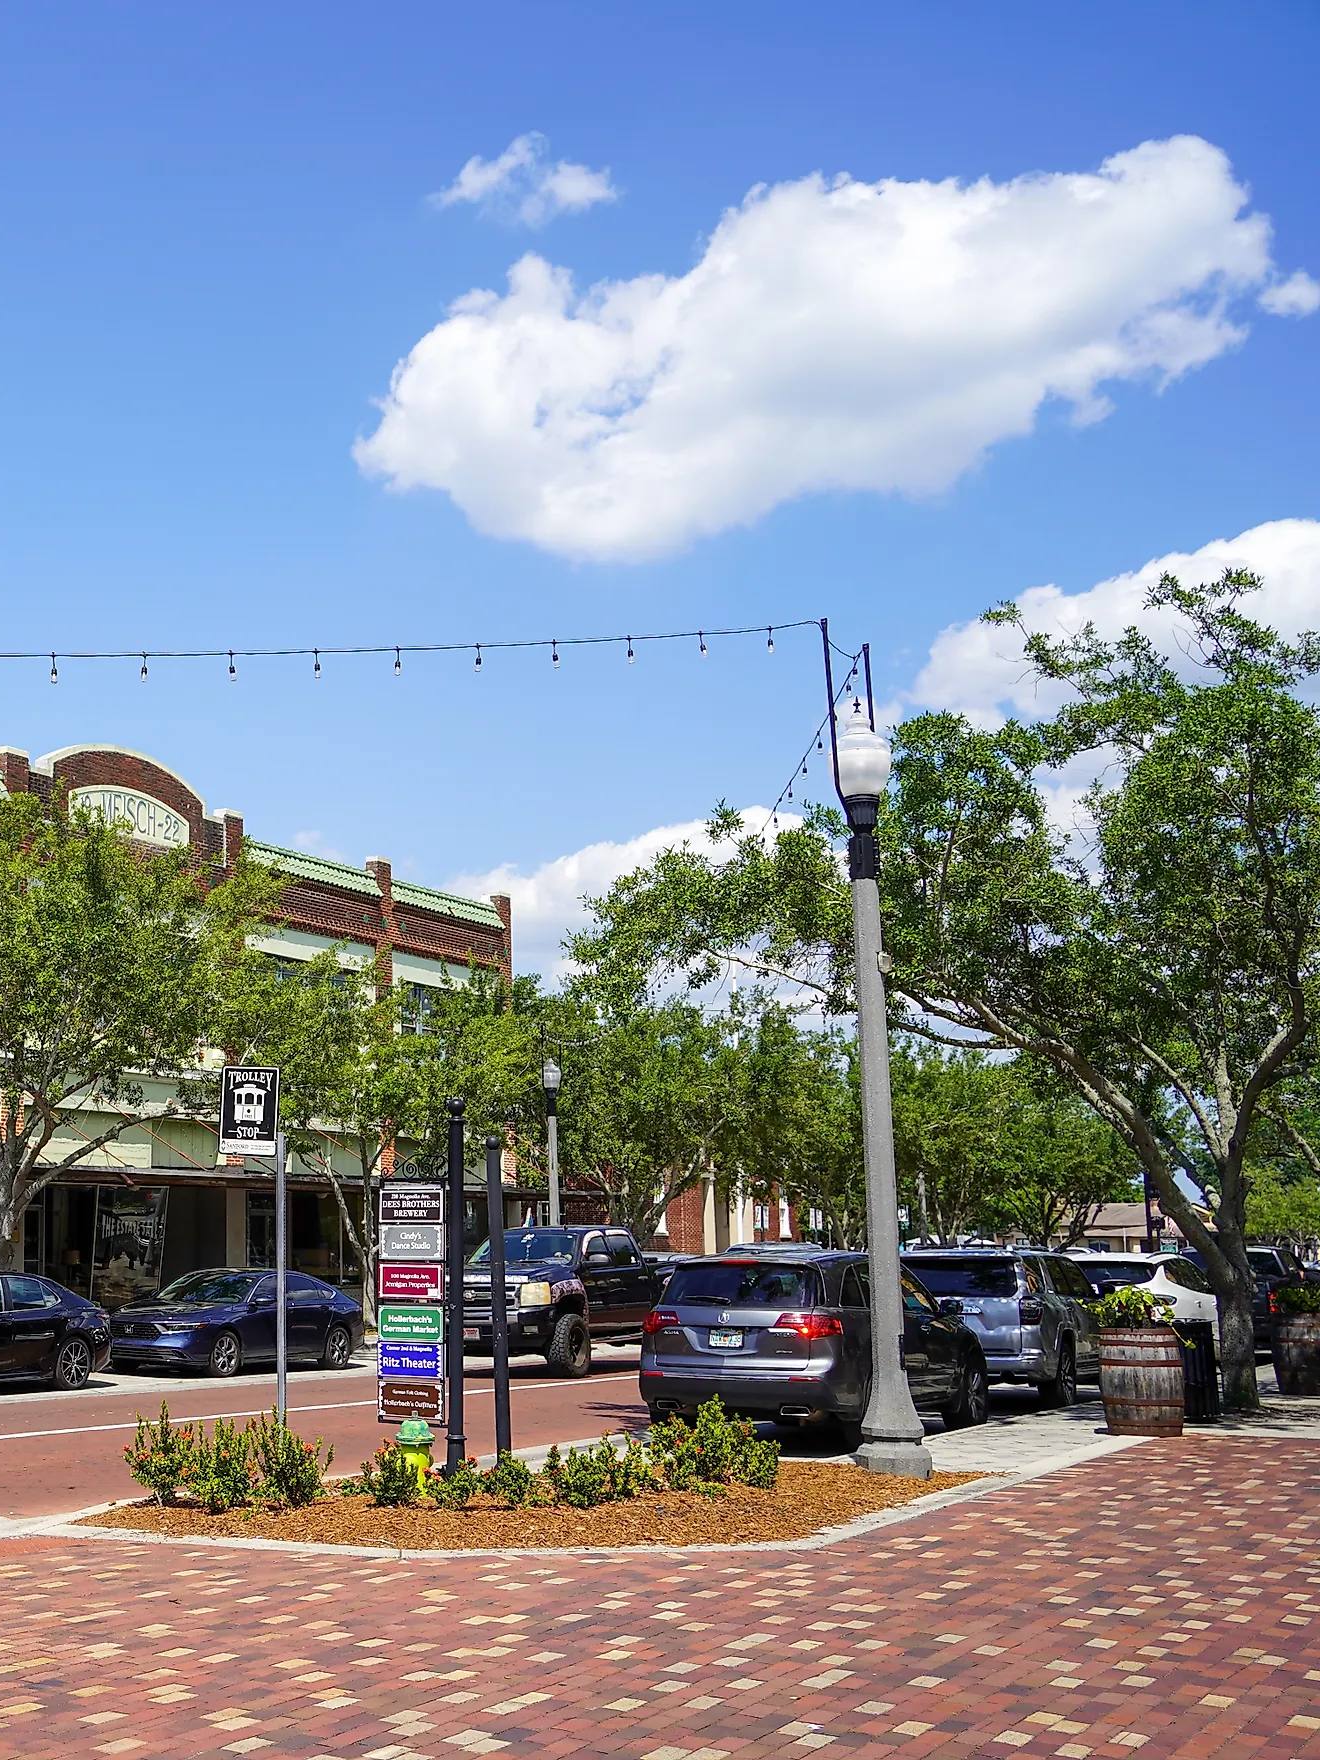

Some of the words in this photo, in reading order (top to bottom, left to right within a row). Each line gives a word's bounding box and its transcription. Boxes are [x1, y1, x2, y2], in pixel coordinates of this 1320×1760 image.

[228, 1070, 273, 1091] TROLLEY
[236, 1126, 260, 1139] STOP
[382, 1200, 400, 1208] DEES
[402, 1200, 440, 1208] BROTHERS
[102, 1213, 116, 1239] THE
[117, 1219, 140, 1237] ESTATE
[400, 1232, 422, 1241] Cindy's
[388, 1315, 433, 1324] Hollerbach's
[413, 1325, 439, 1333] Market
[383, 1357, 400, 1368] Ritz
[401, 1357, 437, 1369] Theater
[384, 1399, 414, 1407] Hollerbach's
